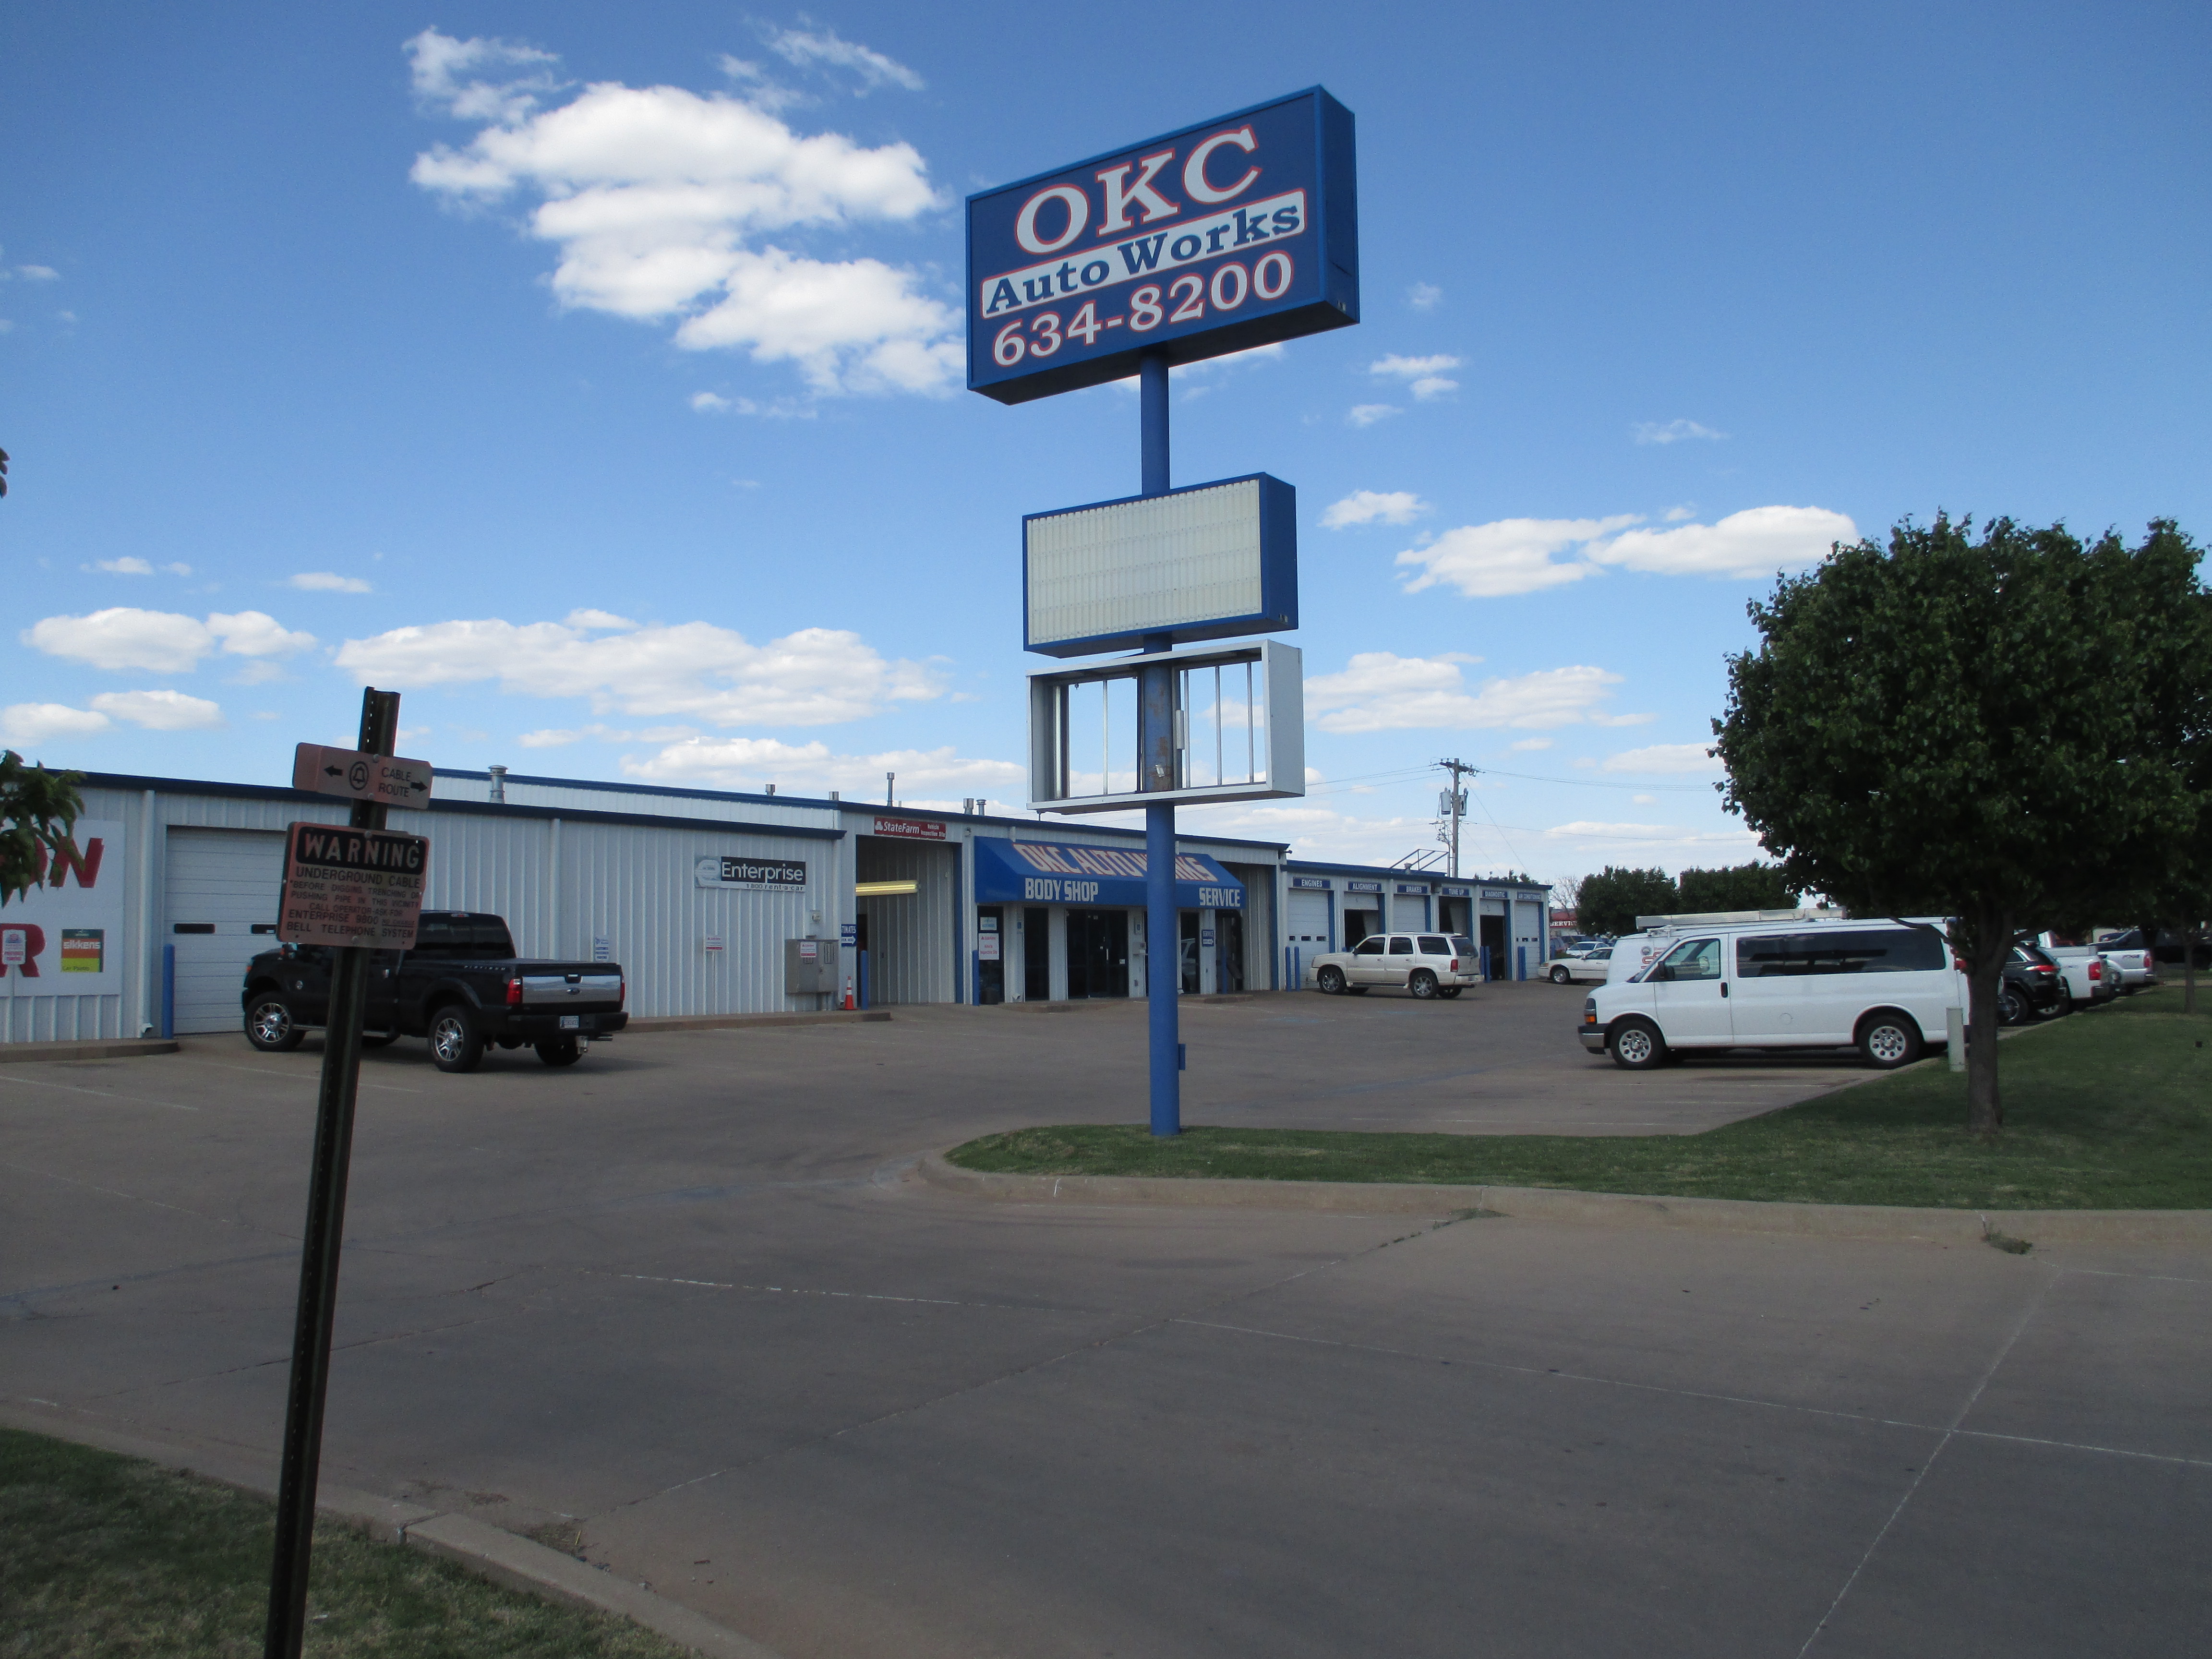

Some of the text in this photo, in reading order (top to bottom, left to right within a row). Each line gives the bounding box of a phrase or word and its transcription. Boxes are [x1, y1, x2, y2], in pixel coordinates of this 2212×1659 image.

[1015, 124, 1262, 255] OKC
[986, 205, 1300, 315] Auto Works
[993, 250, 1294, 367] 634-8200
[382, 767, 411, 781] CABLE
[378, 782, 409, 797] ROUTE
[305, 832, 420, 868] WARNING
[1012, 843, 1083, 874] OKC
[1066, 848, 1144, 878] AUTO
[296, 866, 420, 889] UNDERGROUND CABLE
[721, 862, 804, 884] Enterprise
[331, 884, 362, 894] DIGGING
[368, 887, 406, 898] TRENCHING
[1025, 878, 1098, 902] BODY SHOP
[1301, 879, 1322, 888] ENGINES
[1352, 883, 1378, 891] ALIGNMENT
[291, 890, 328, 902] PUSHING
[334, 895, 352, 903] PIPE
[1199, 887, 1241, 907] SERVICE
[309, 902, 330, 912] CALL
[289, 909, 350, 923] ENTERPRISE
[356, 914, 379, 925] 9800
[287, 921, 414, 938] BELL TELEPHONE SYSTEM
[63, 939, 101, 950] sikkens
